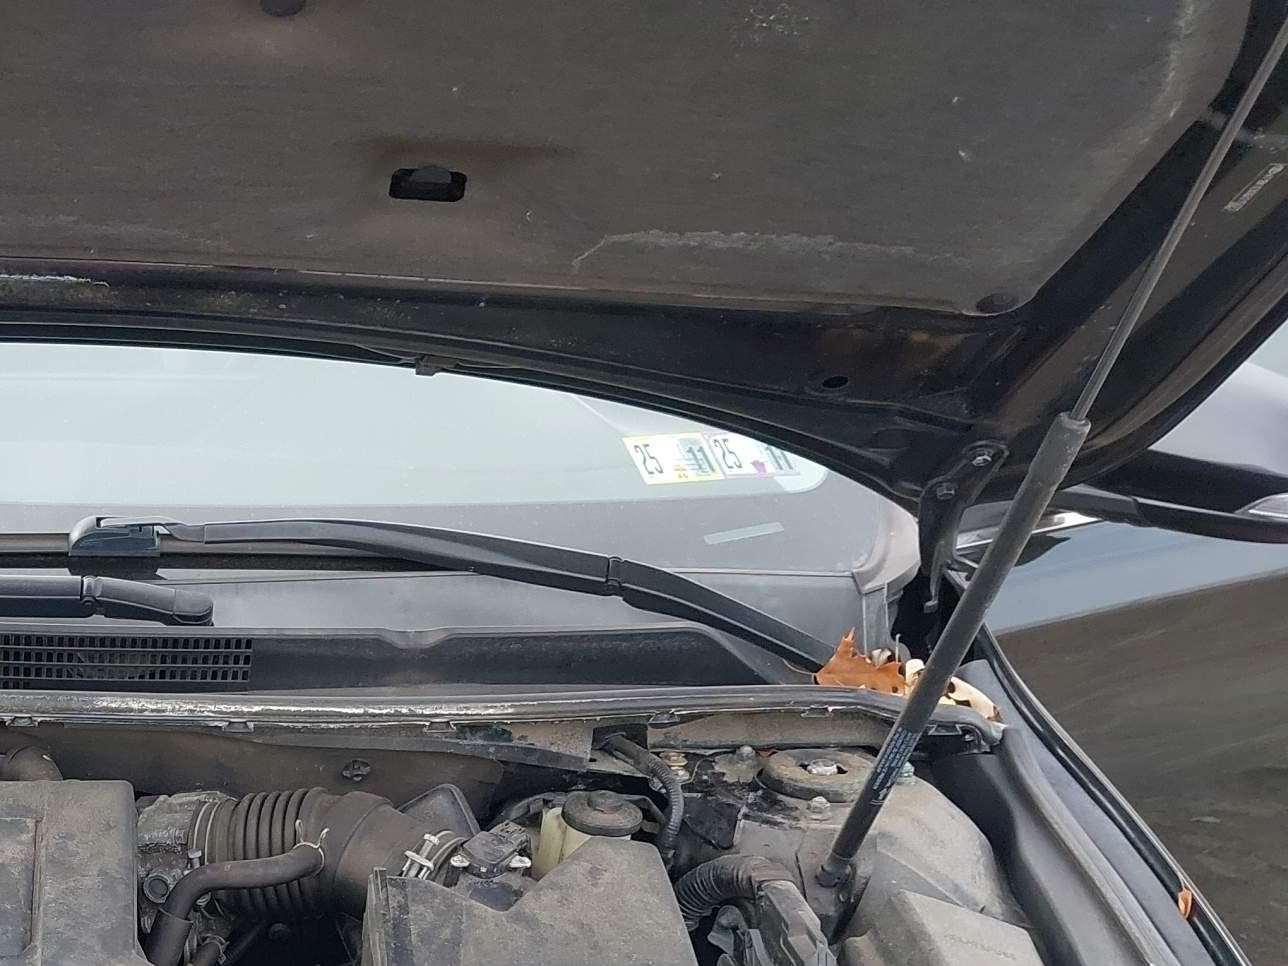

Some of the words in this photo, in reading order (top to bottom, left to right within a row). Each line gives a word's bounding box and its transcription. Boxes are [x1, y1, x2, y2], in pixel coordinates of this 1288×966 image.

[633, 444, 664, 474] 25
[686, 446, 715, 473] 11
[713, 438, 743, 469] 25
